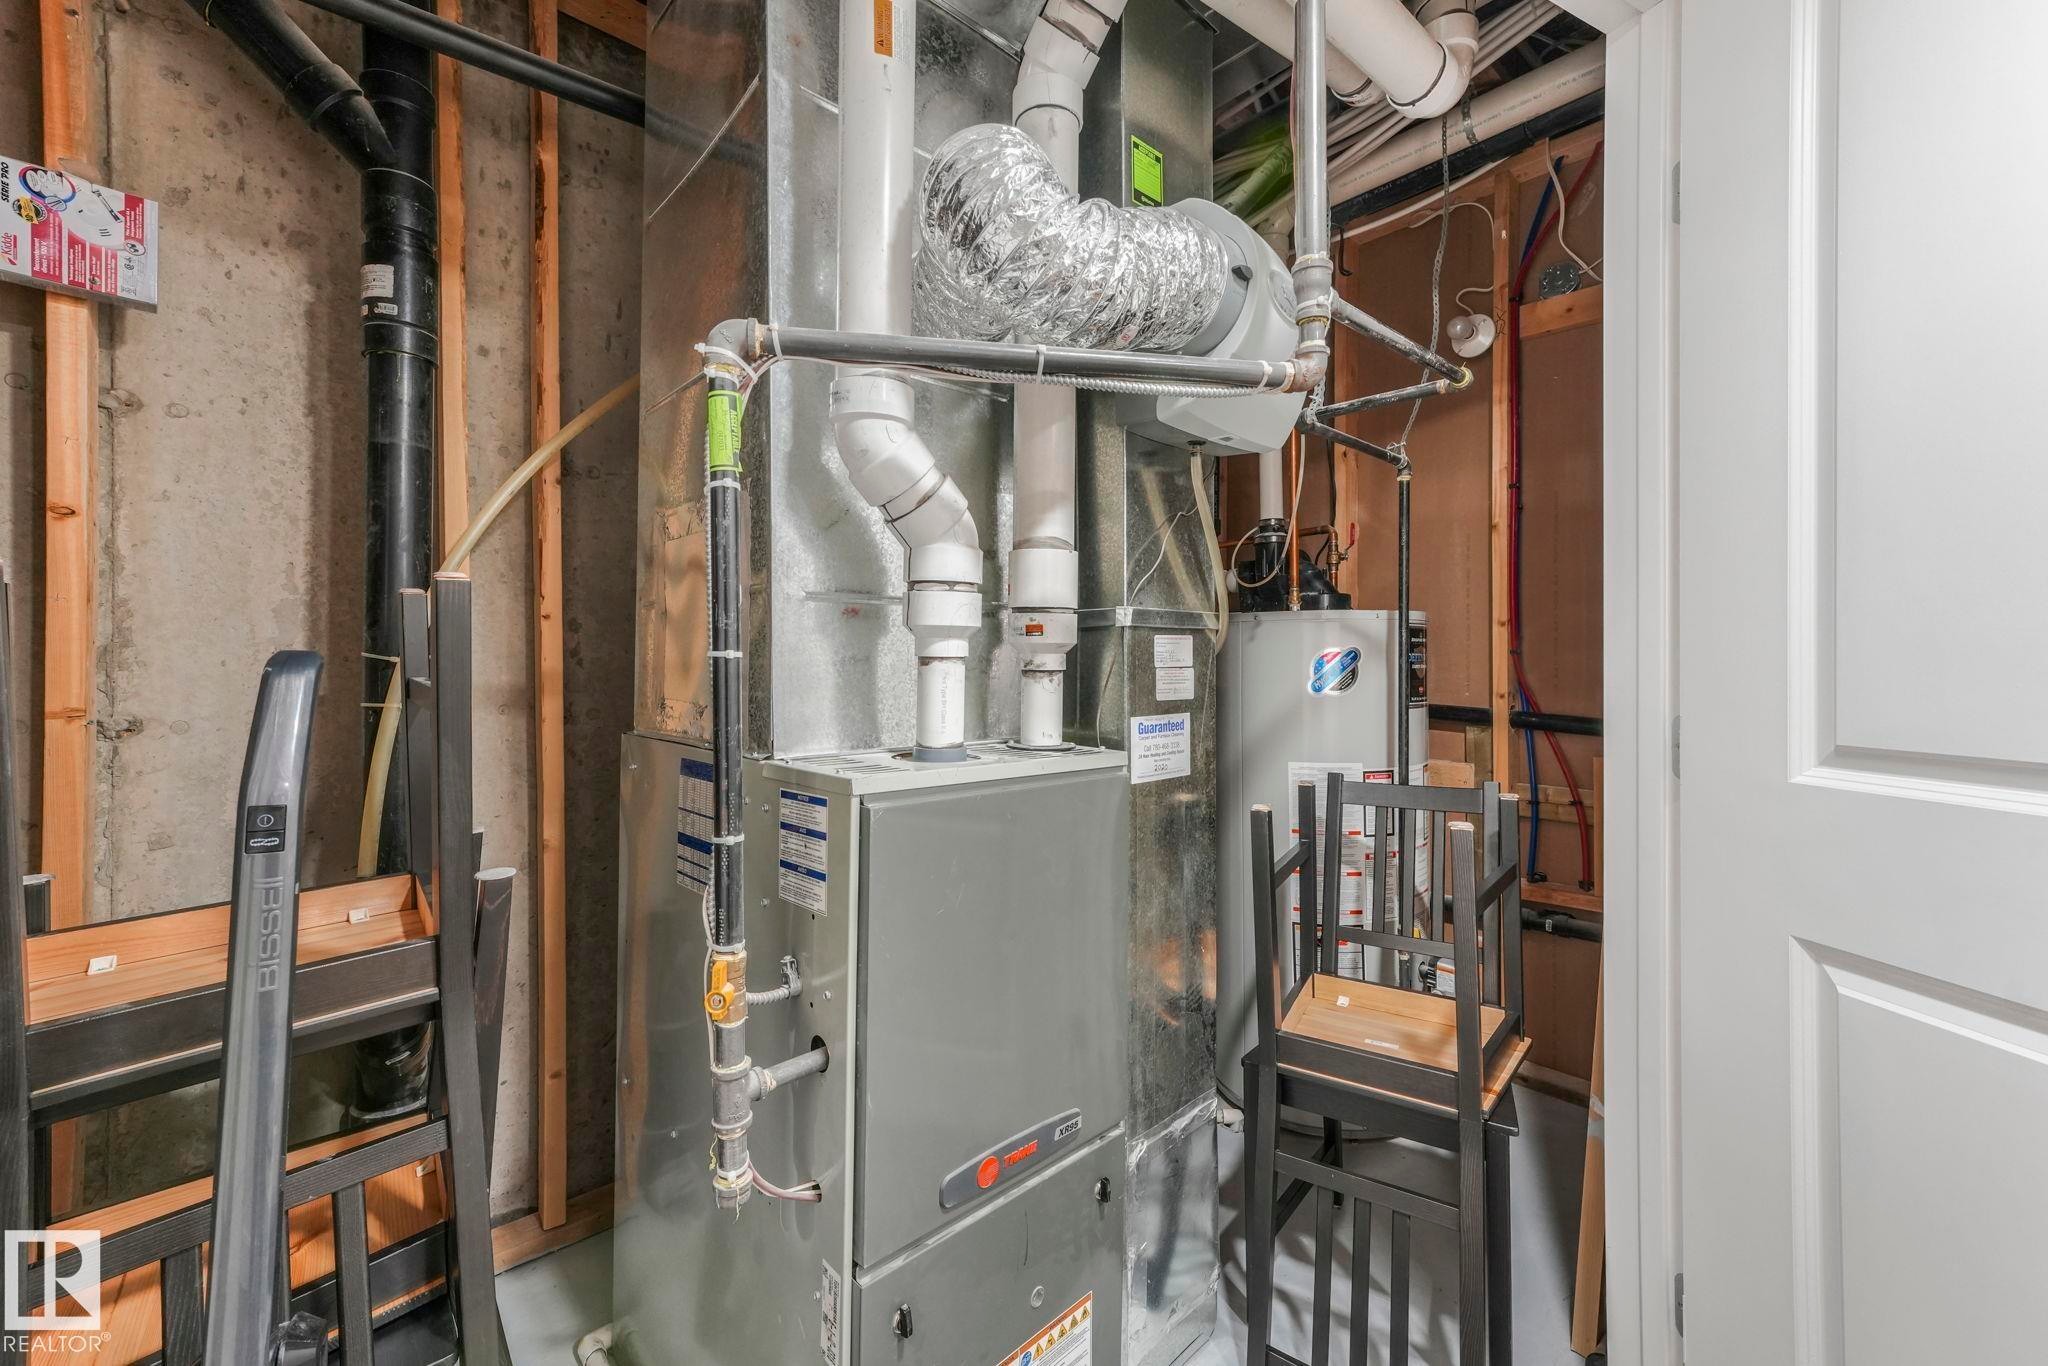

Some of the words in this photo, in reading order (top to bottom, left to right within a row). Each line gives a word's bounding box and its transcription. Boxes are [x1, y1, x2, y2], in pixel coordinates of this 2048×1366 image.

[1, 161, 9, 179] PRO
[1, 232, 13, 256] Kidde
[730, 409, 739, 454] ACCEPTABLE
[1138, 719, 1185, 735] Guaranteed
[1058, 1120, 1079, 1138] XR95
